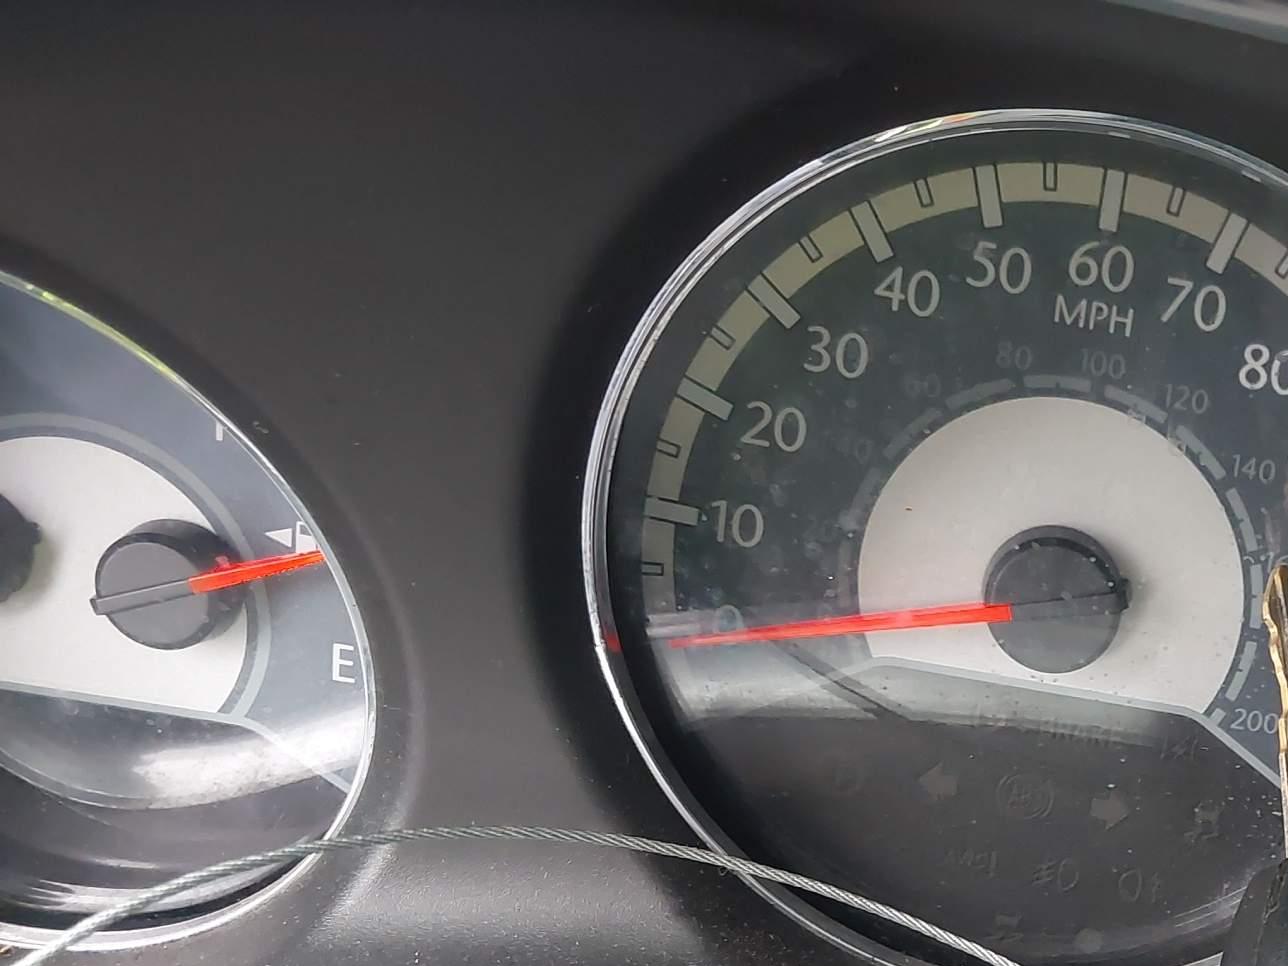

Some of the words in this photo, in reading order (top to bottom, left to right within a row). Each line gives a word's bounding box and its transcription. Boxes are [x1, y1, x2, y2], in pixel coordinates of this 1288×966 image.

[966, 241, 1031, 294] 50
[1068, 241, 1134, 292] 60
[874, 266, 940, 317] 40
[1160, 277, 1226, 331] 70
[1054, 295, 1134, 336] MPH
[804, 325, 868, 378] 30
[995, 346, 1031, 370] 80
[1080, 348, 1126, 379] 100
[1164, 384, 1209, 412] 120
[739, 401, 806, 452] 20
[1231, 454, 1276, 484] 140
[710, 499, 764, 547] 10
[332, 642, 355, 684] E
[1230, 708, 1278, 734] 200
